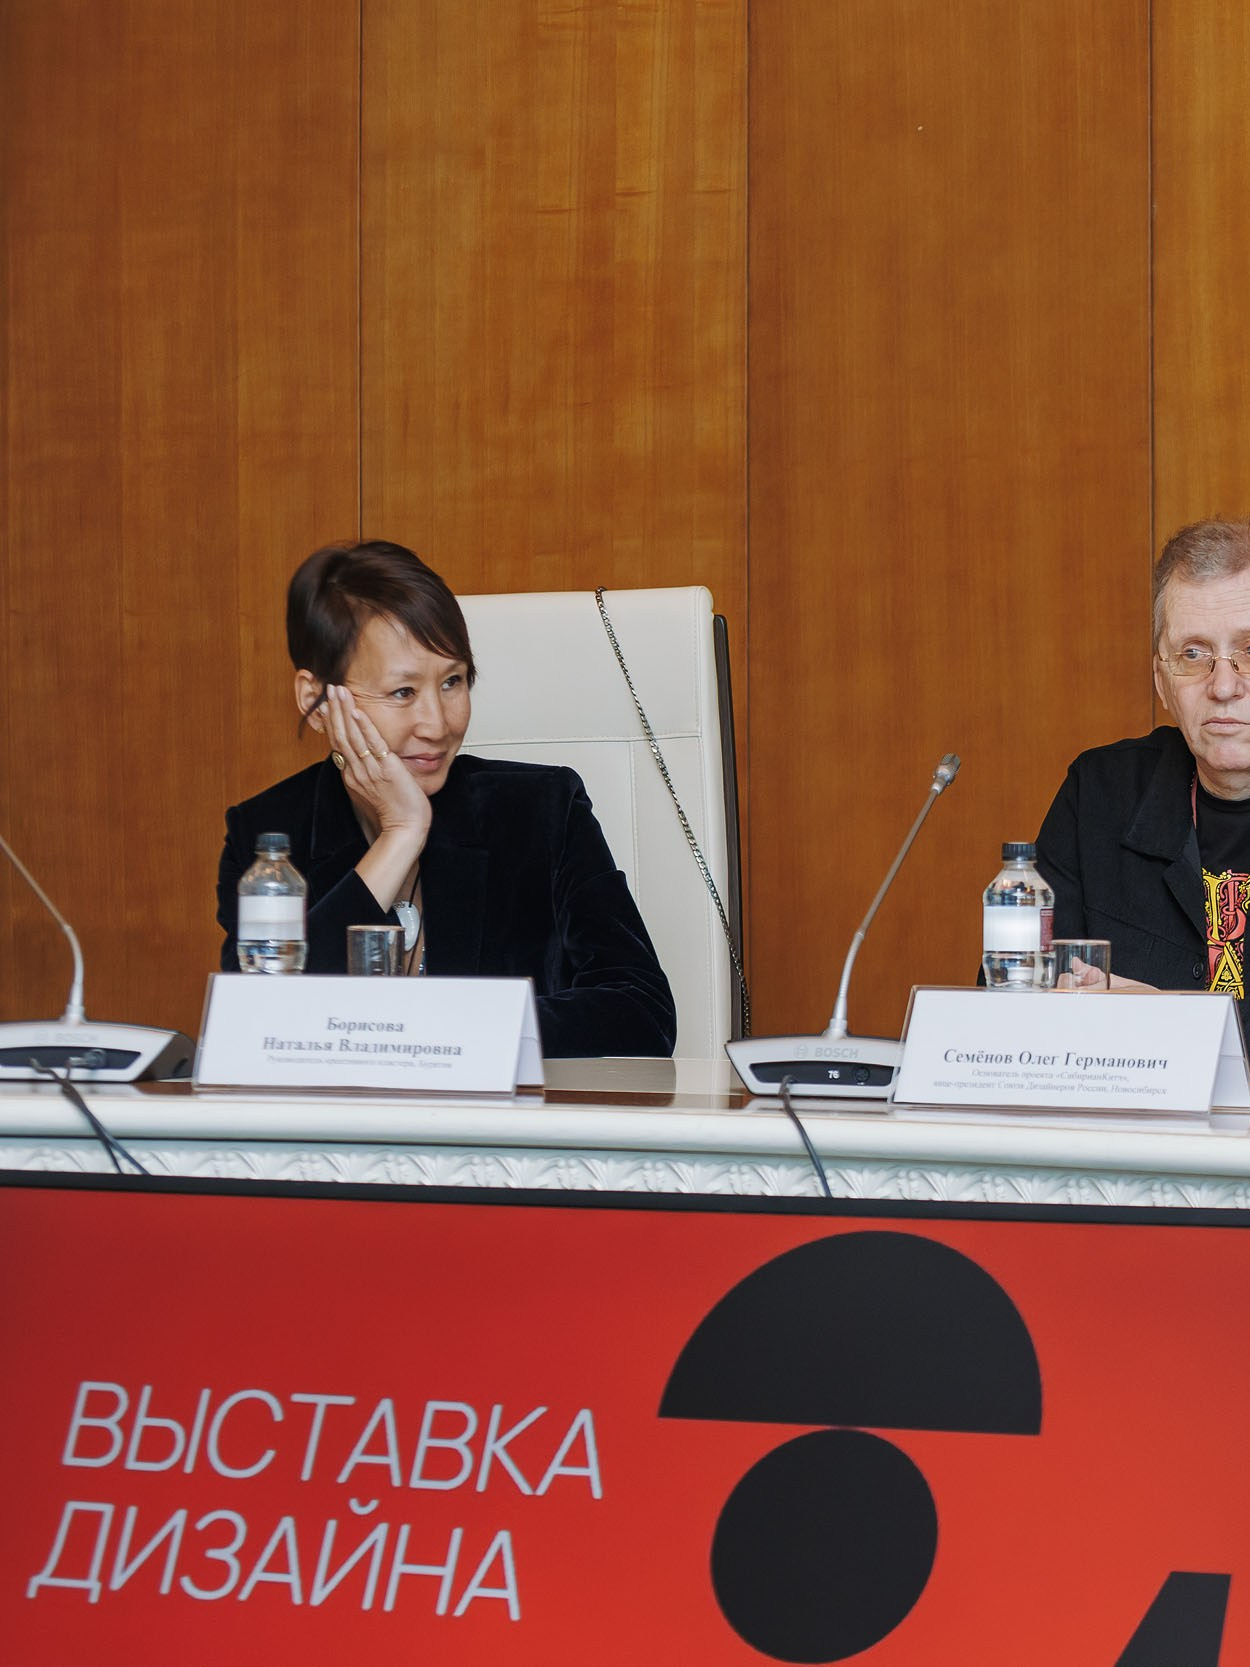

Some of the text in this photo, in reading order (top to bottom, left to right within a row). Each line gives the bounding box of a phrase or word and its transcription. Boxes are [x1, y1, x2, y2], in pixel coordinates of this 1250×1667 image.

[326, 1016, 405, 1034] Борисова
[262, 1036, 463, 1058] Наталья Владимировна
[815, 1047, 859, 1058] BOSCH
[943, 1048, 1169, 1071] Семёнов Олег Германович
[828, 1070, 840, 1079] 76
[61, 1380, 603, 1500] ВЫСТАВКА
[26, 1498, 521, 1621] ДИЗАЙНА
